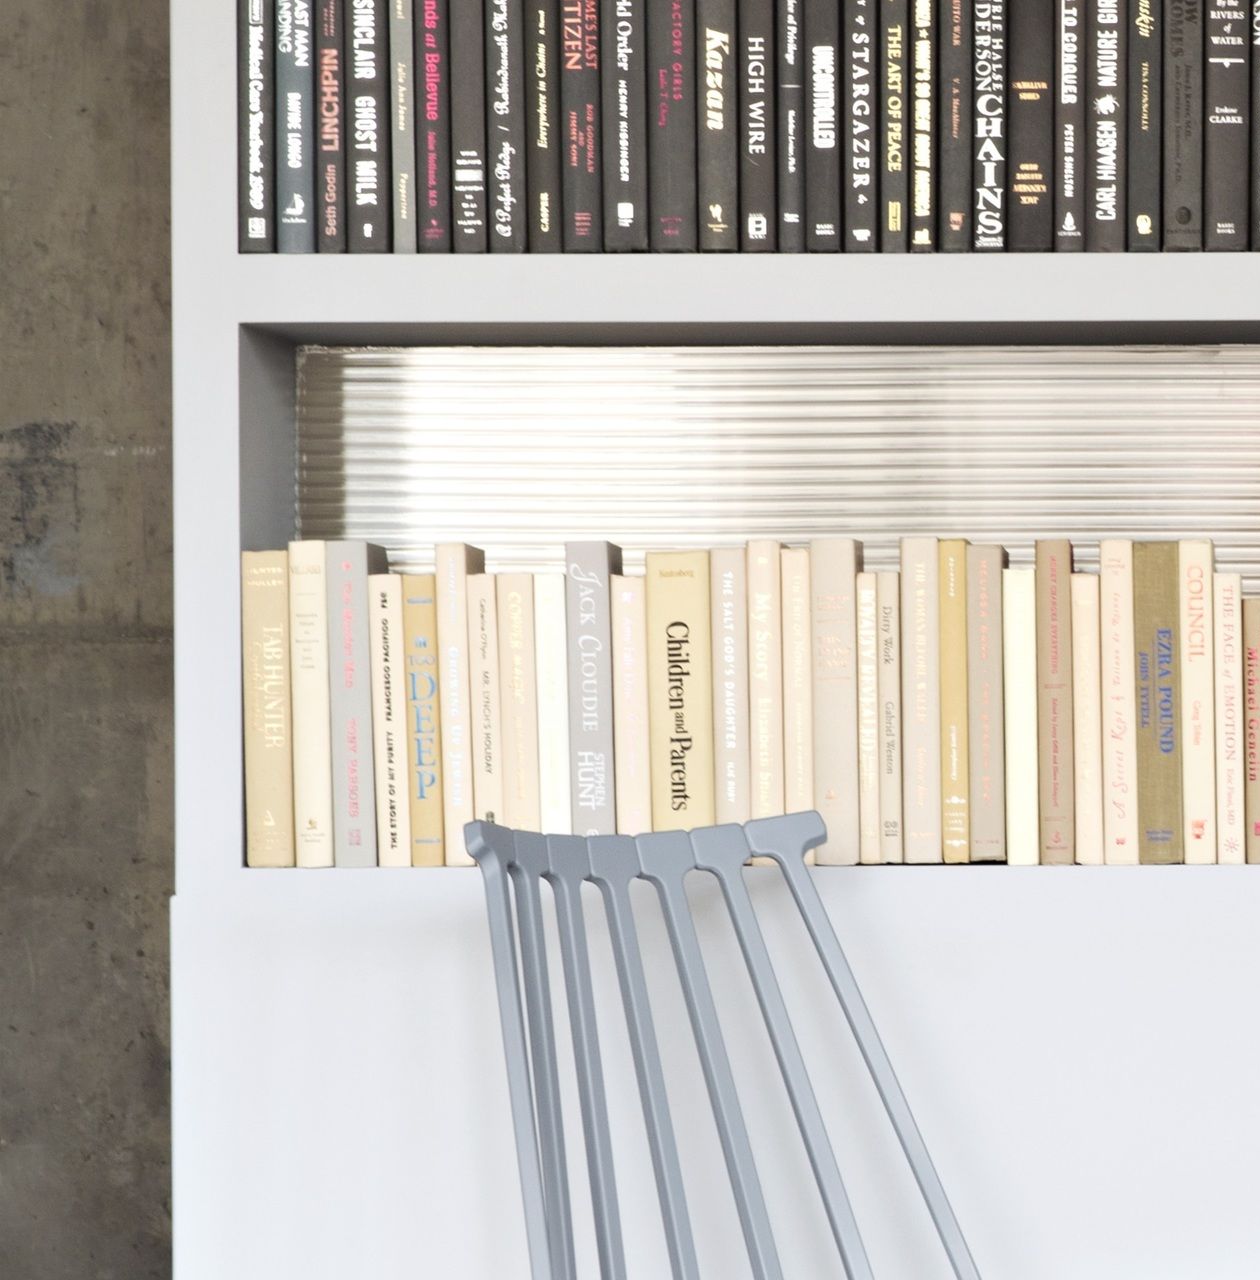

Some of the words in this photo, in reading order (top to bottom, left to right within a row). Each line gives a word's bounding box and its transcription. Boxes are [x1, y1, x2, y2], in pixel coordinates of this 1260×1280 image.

[425, 34, 437, 48] at
[1063, 7, 1077, 27] TO
[294, 29, 309, 67] MAN
[586, 35, 597, 70] LAST
[617, 21, 632, 71] Order
[747, 37, 765, 94] HIGH
[992, 38, 1003, 91] HALSE
[1063, 32, 1078, 104] CONQUER
[1097, 30, 1118, 87] NATURE
[321, 49, 339, 152] LINCHPIN
[425, 53, 440, 120] Bellevue
[705, 27, 729, 131] Kazan
[354, 96, 377, 152] GHOST
[749, 101, 765, 155] WIRE
[852, 32, 870, 188] STARGAZER
[975, 94, 1004, 235] CHAINS
[1096, 120, 1117, 180] HIAASEN
[325, 164, 338, 203] Godin
[356, 160, 378, 206] MILK
[1095, 183, 1117, 220] CARL
[326, 205, 337, 236] Seth
[570, 563, 602, 625] JACK
[881, 606, 893, 635] Dirty
[262, 623, 283, 660] TAB
[665, 621, 691, 710] Children
[882, 637, 894, 664] Work
[1156, 628, 1174, 679] EZRA
[263, 665, 285, 748] HUNTER
[577, 634, 603, 732] CLOUDIE
[674, 712, 688, 734] and
[884, 701, 896, 737] Gabriel
[1158, 687, 1175, 755] POUND
[577, 751, 596, 810] HUNT
[669, 736, 693, 811] Parents
[885, 740, 896, 775] Weston
